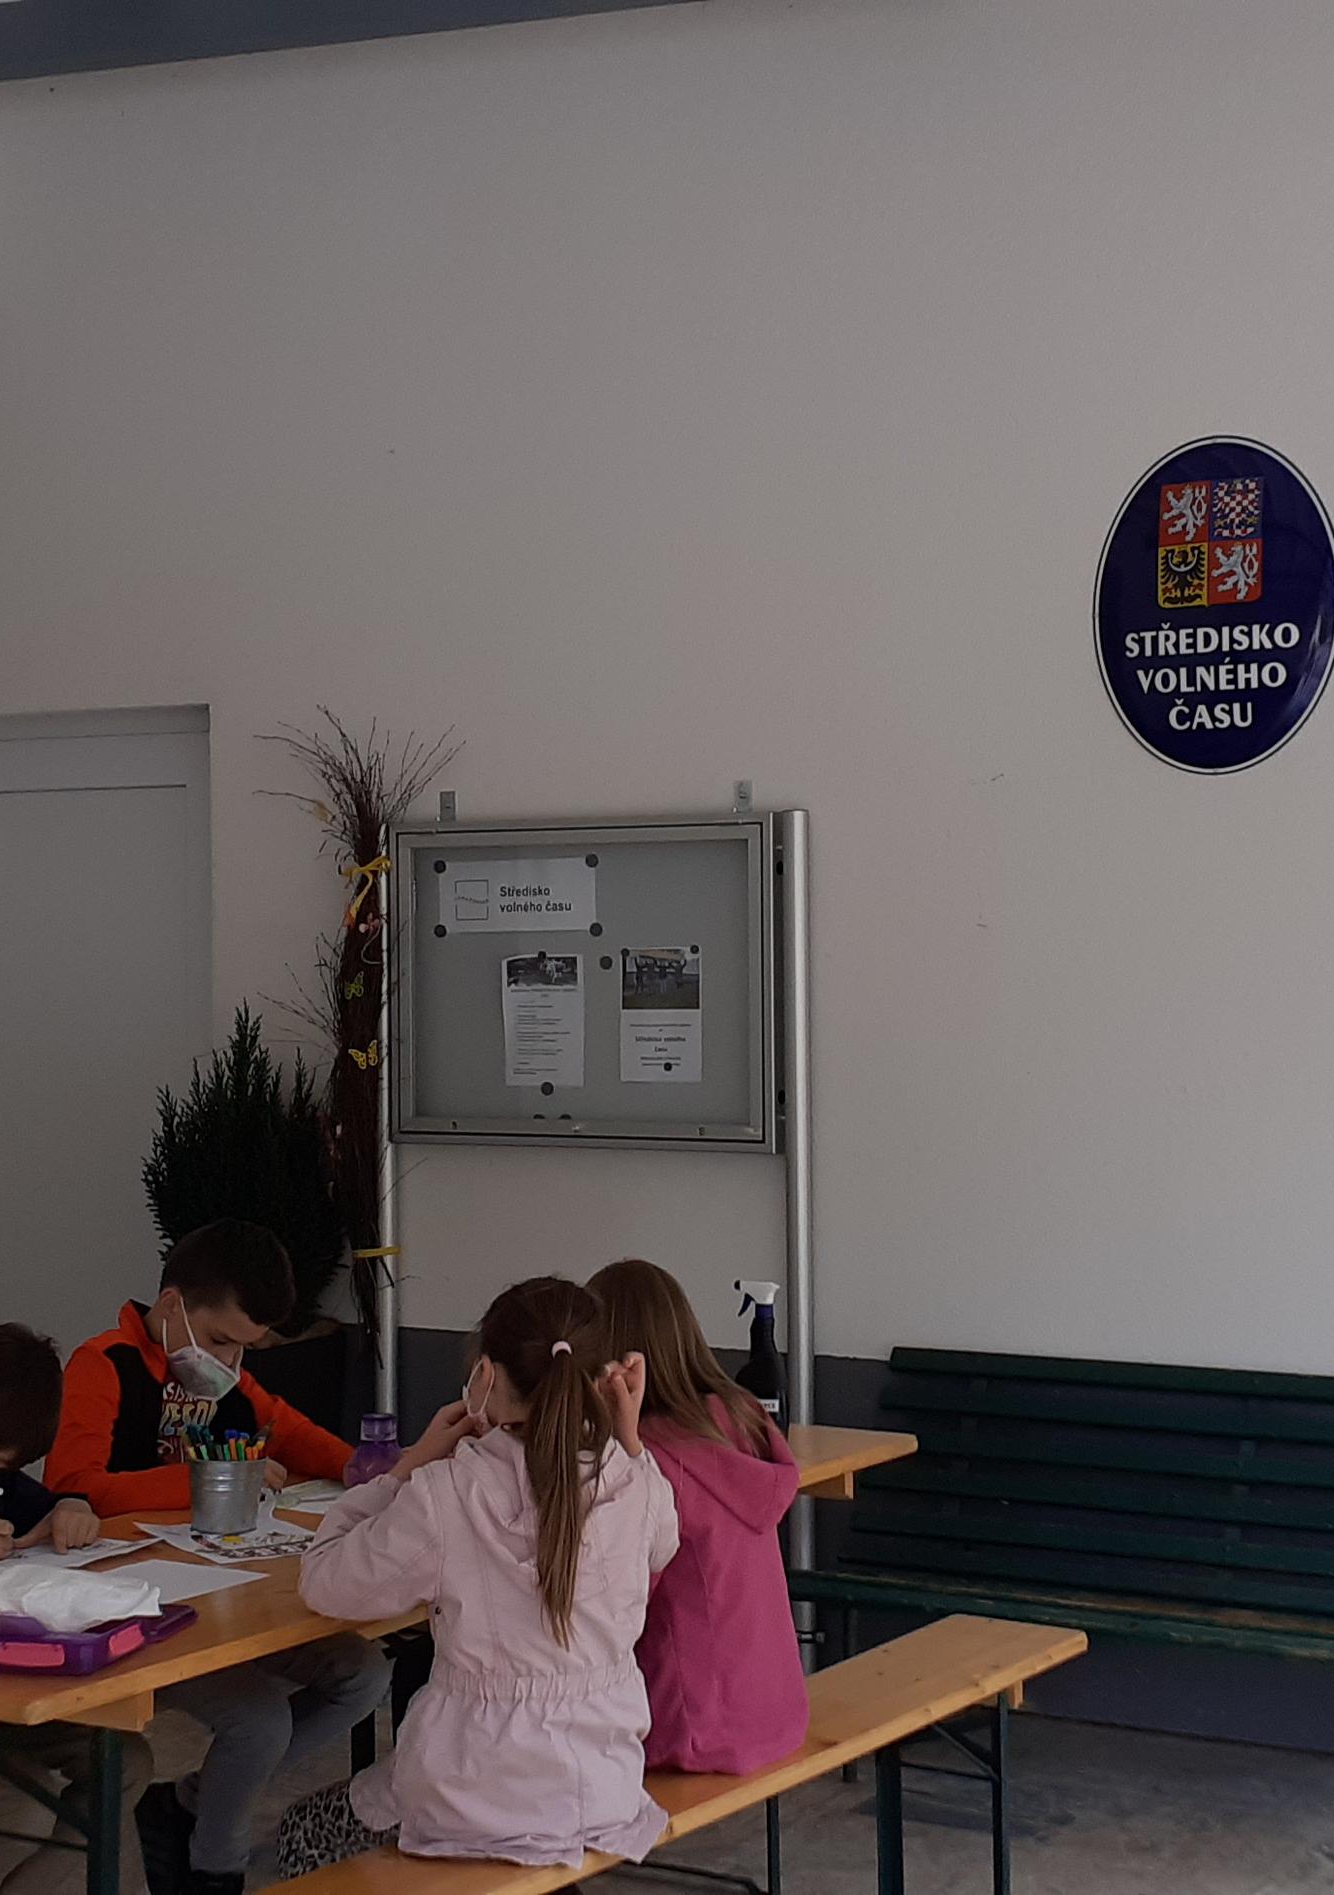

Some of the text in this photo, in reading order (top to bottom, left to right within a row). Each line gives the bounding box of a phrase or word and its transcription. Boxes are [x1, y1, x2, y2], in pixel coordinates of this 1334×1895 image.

[1125, 622, 1300, 658] STŘEDISKO
[1136, 657, 1287, 694] VOLNÉHO
[1168, 699, 1253, 731] ČASU
[499, 885, 551, 897] Středisko
[499, 900, 572, 913] volného času
